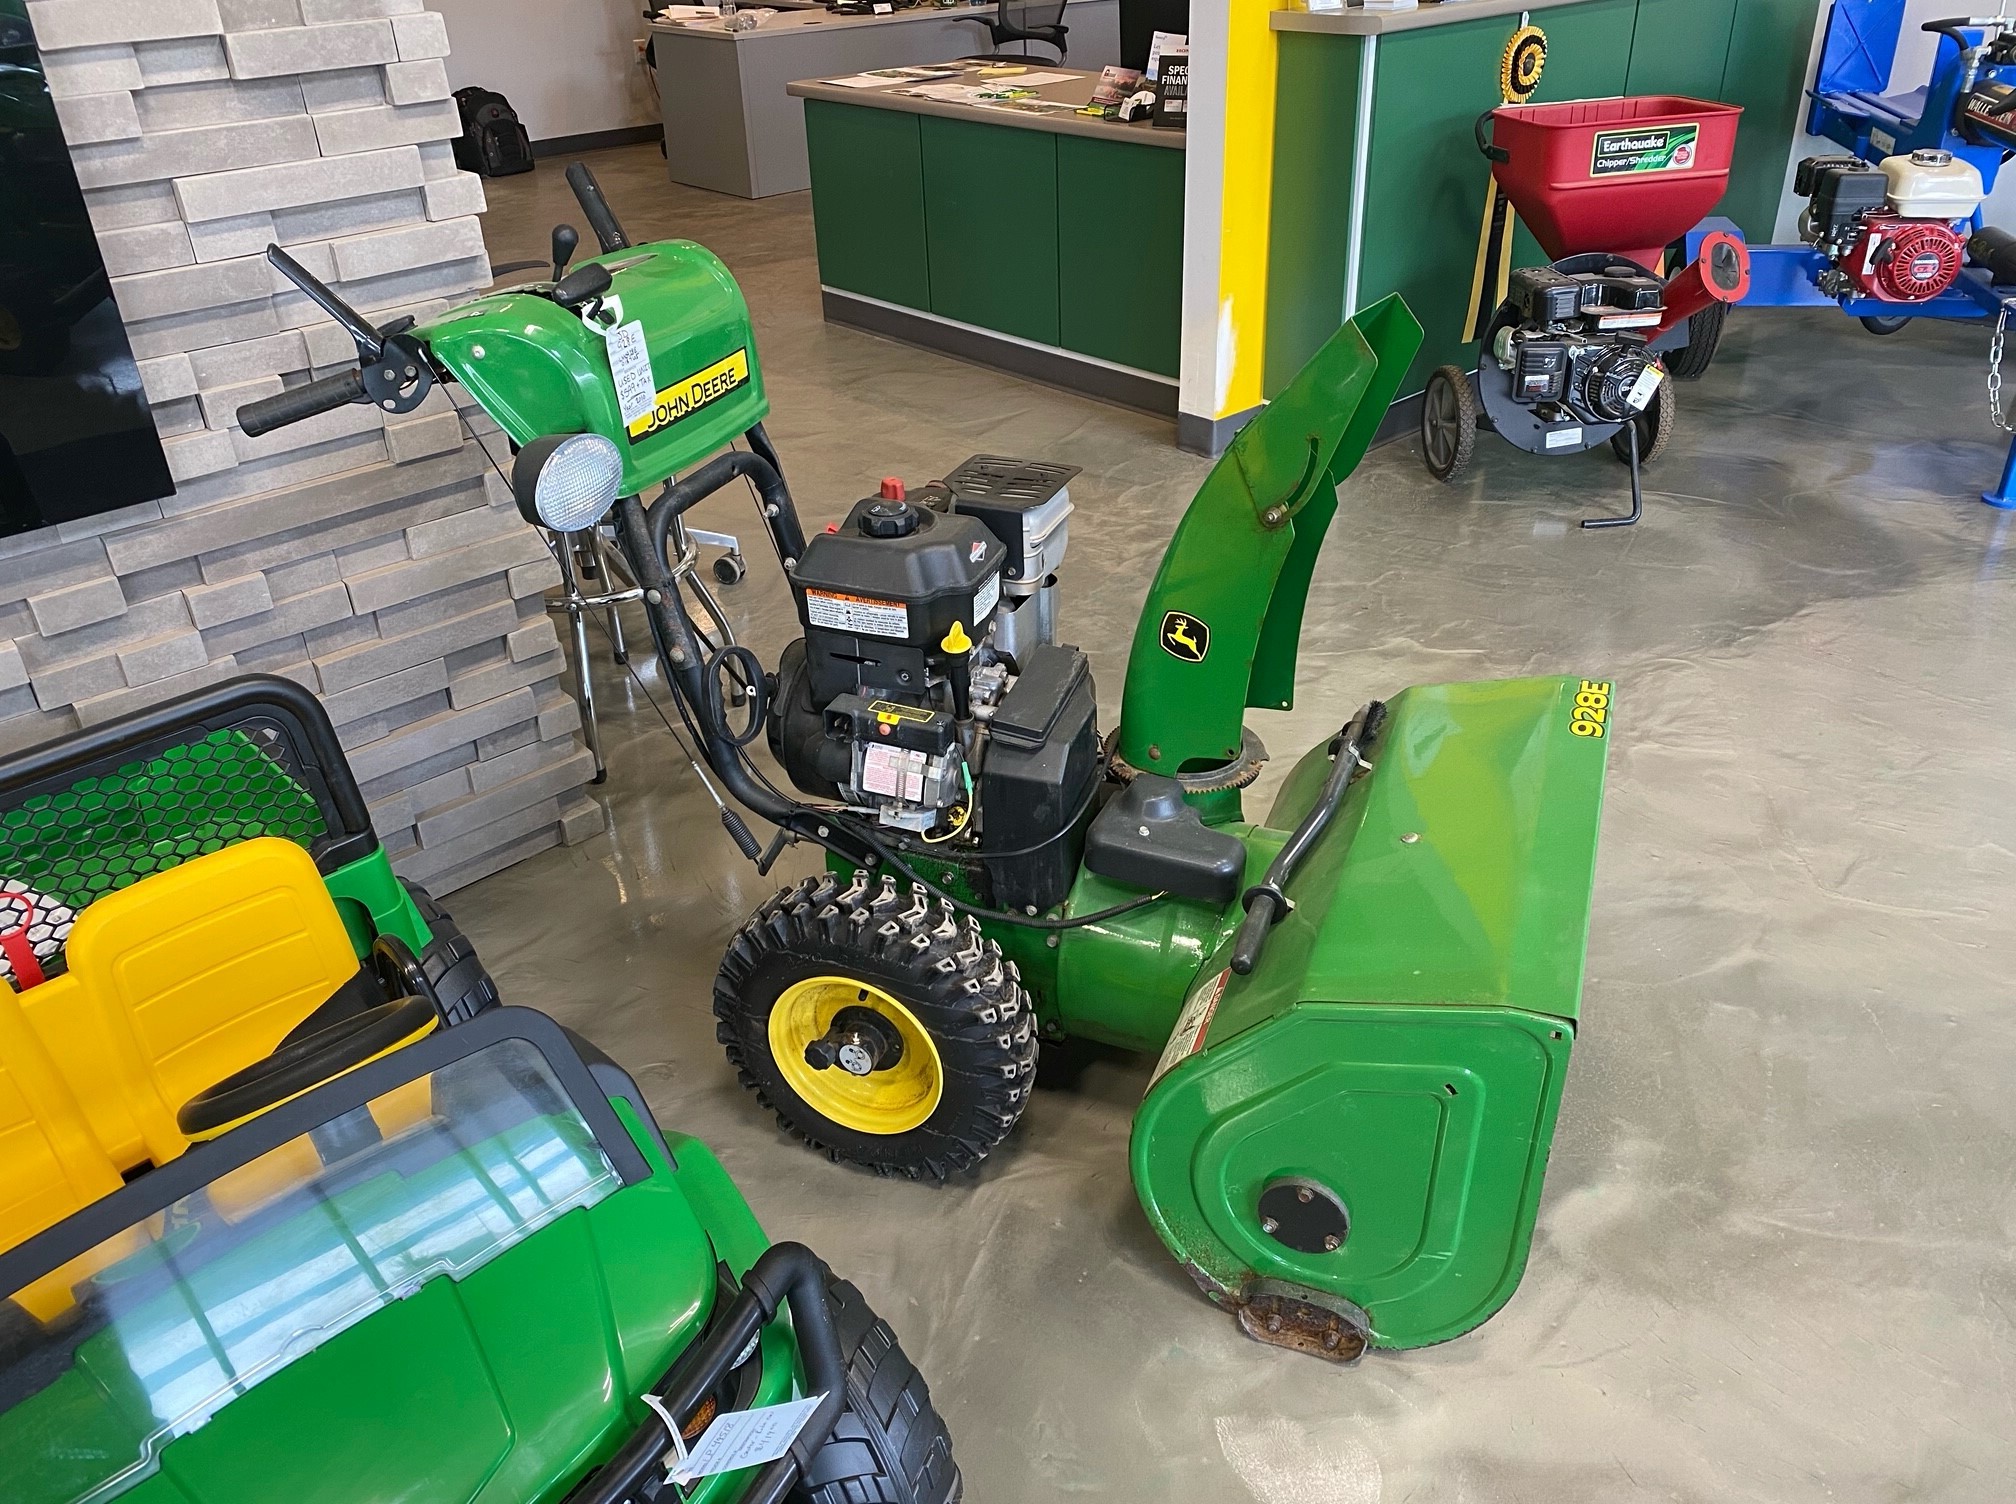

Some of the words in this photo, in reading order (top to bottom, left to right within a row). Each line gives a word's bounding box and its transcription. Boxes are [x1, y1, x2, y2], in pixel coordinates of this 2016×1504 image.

[1168, 65, 1188, 75] SPEC
[1161, 75, 1187, 85] FINAN
[1163, 85, 1187, 96] AVAIL
[618, 372, 636, 388] USED
[647, 392, 690, 429] JOHN
[691, 367, 737, 406] DEERE
[1568, 679, 1611, 738] 928E
